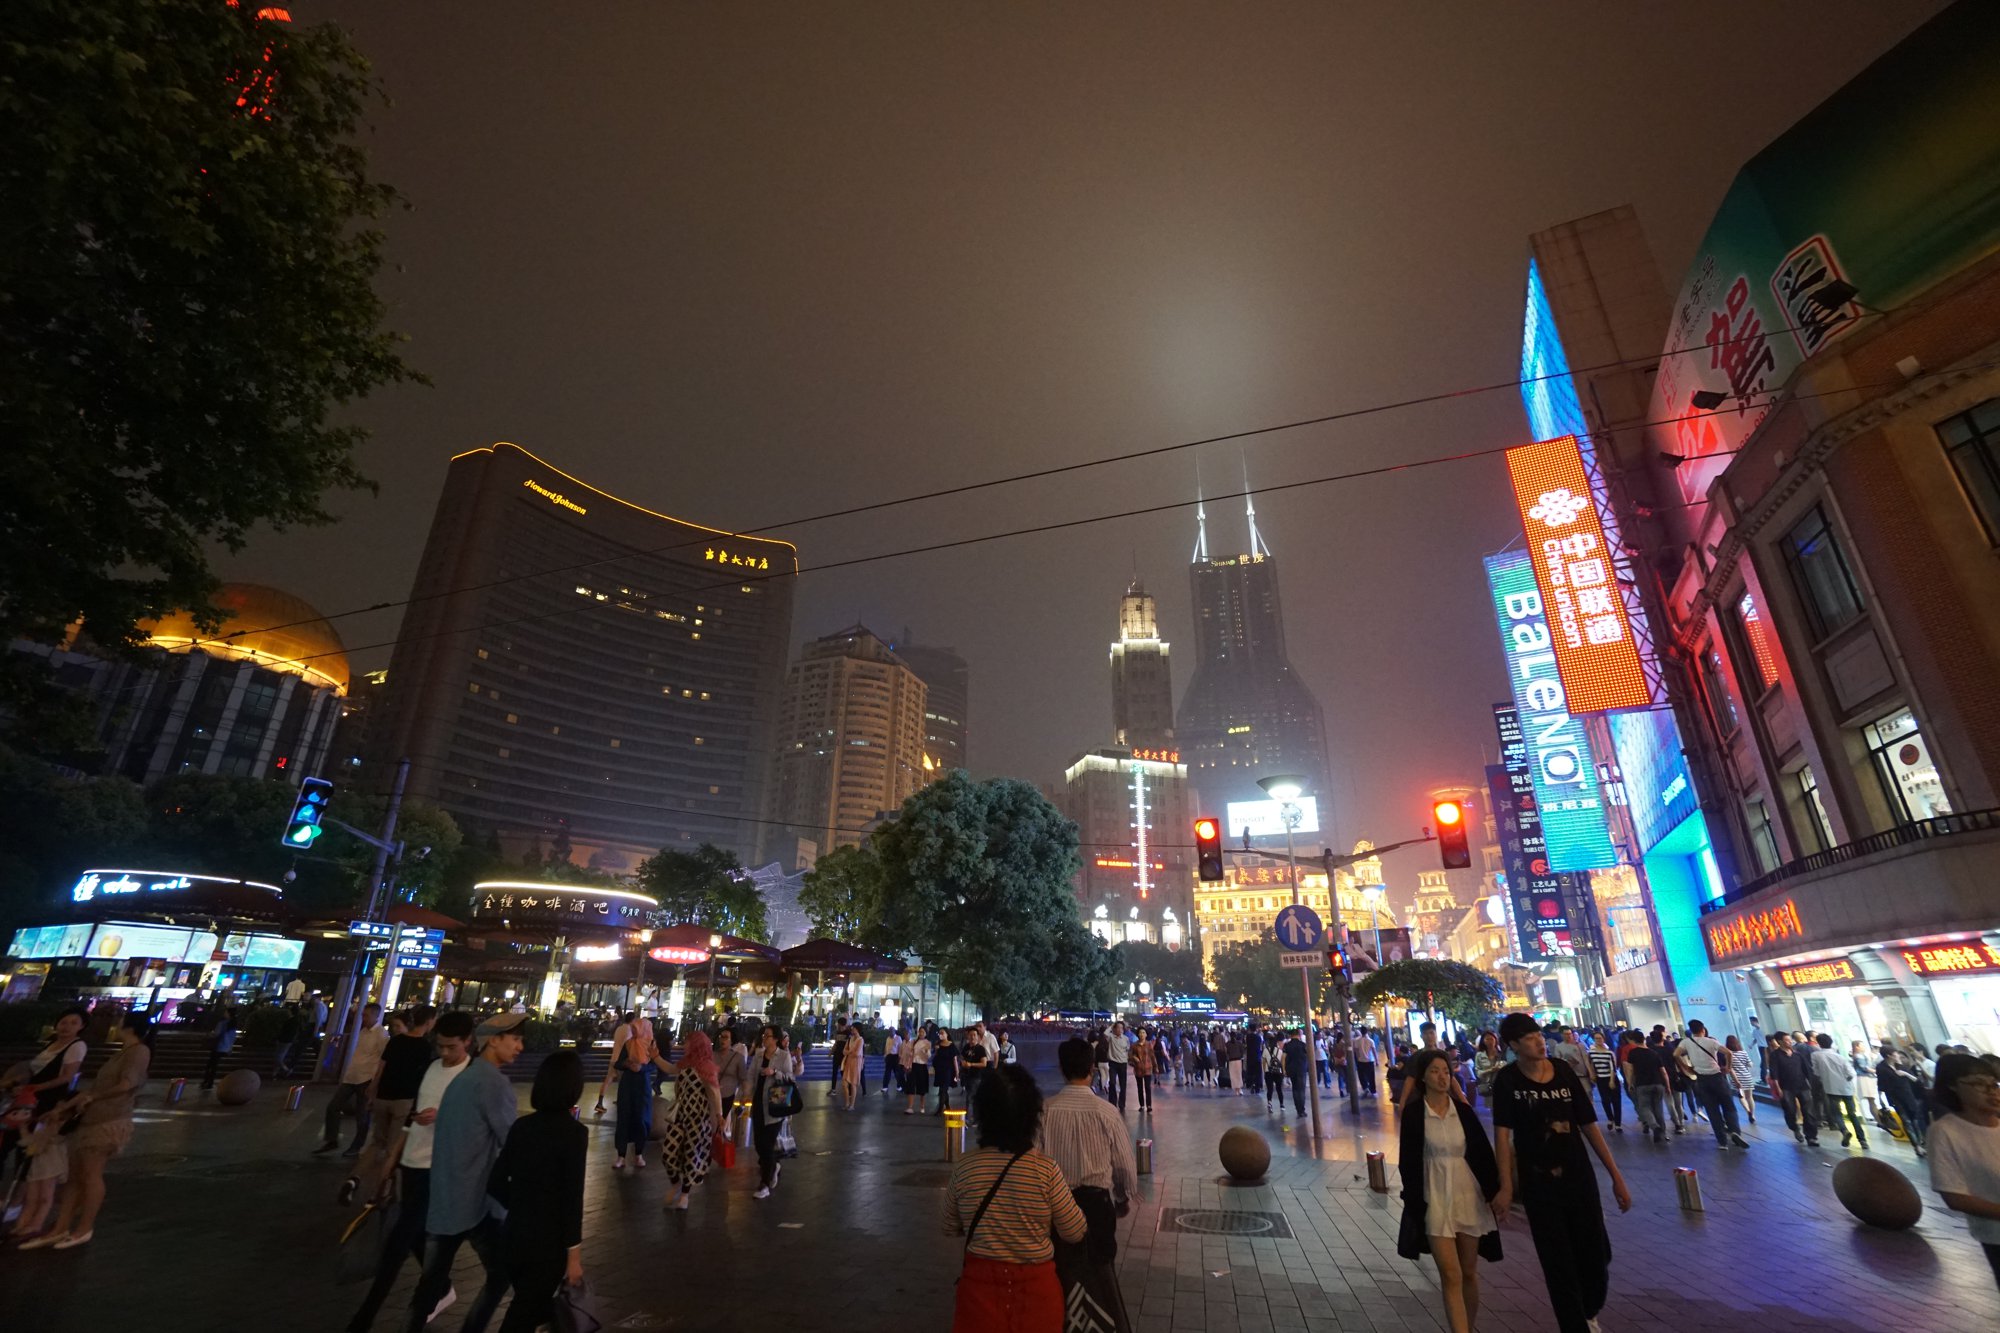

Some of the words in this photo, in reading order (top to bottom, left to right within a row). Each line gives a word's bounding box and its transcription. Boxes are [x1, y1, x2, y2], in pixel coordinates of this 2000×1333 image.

[524, 479, 556, 500] Howard
[553, 494, 587, 515] Johnson
[1238, 552, 1265, 566] 世茂
[1561, 532, 1623, 645] 中国联通
[1920, 946, 1987, 972] 品牌特色
